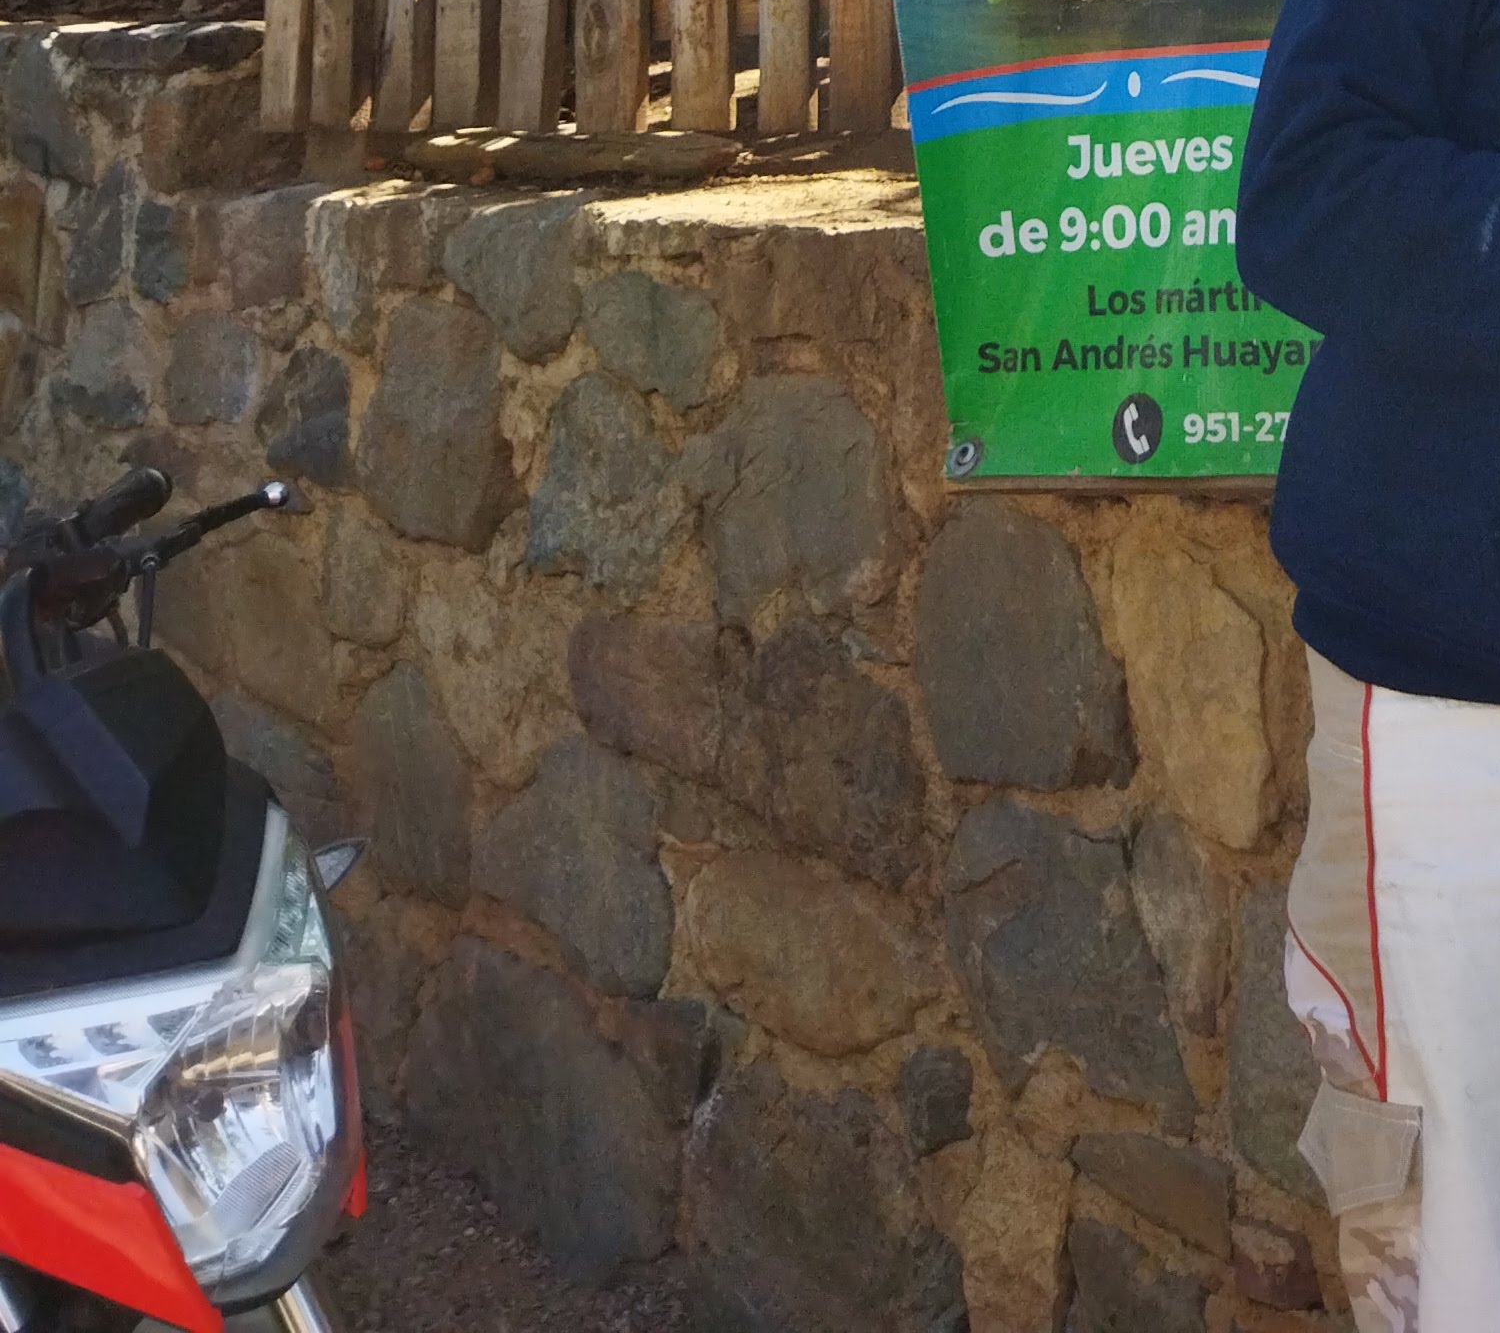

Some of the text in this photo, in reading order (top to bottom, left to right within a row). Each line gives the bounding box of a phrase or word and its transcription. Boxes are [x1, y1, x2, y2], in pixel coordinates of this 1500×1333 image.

[1066, 134, 1235, 180] Jueves
[978, 210, 1049, 258] de
[1059, 202, 1172, 253] 9:00
[1087, 284, 1147, 317] Los
[977, 340, 1042, 375] San
[1052, 335, 1174, 373] Andrés
